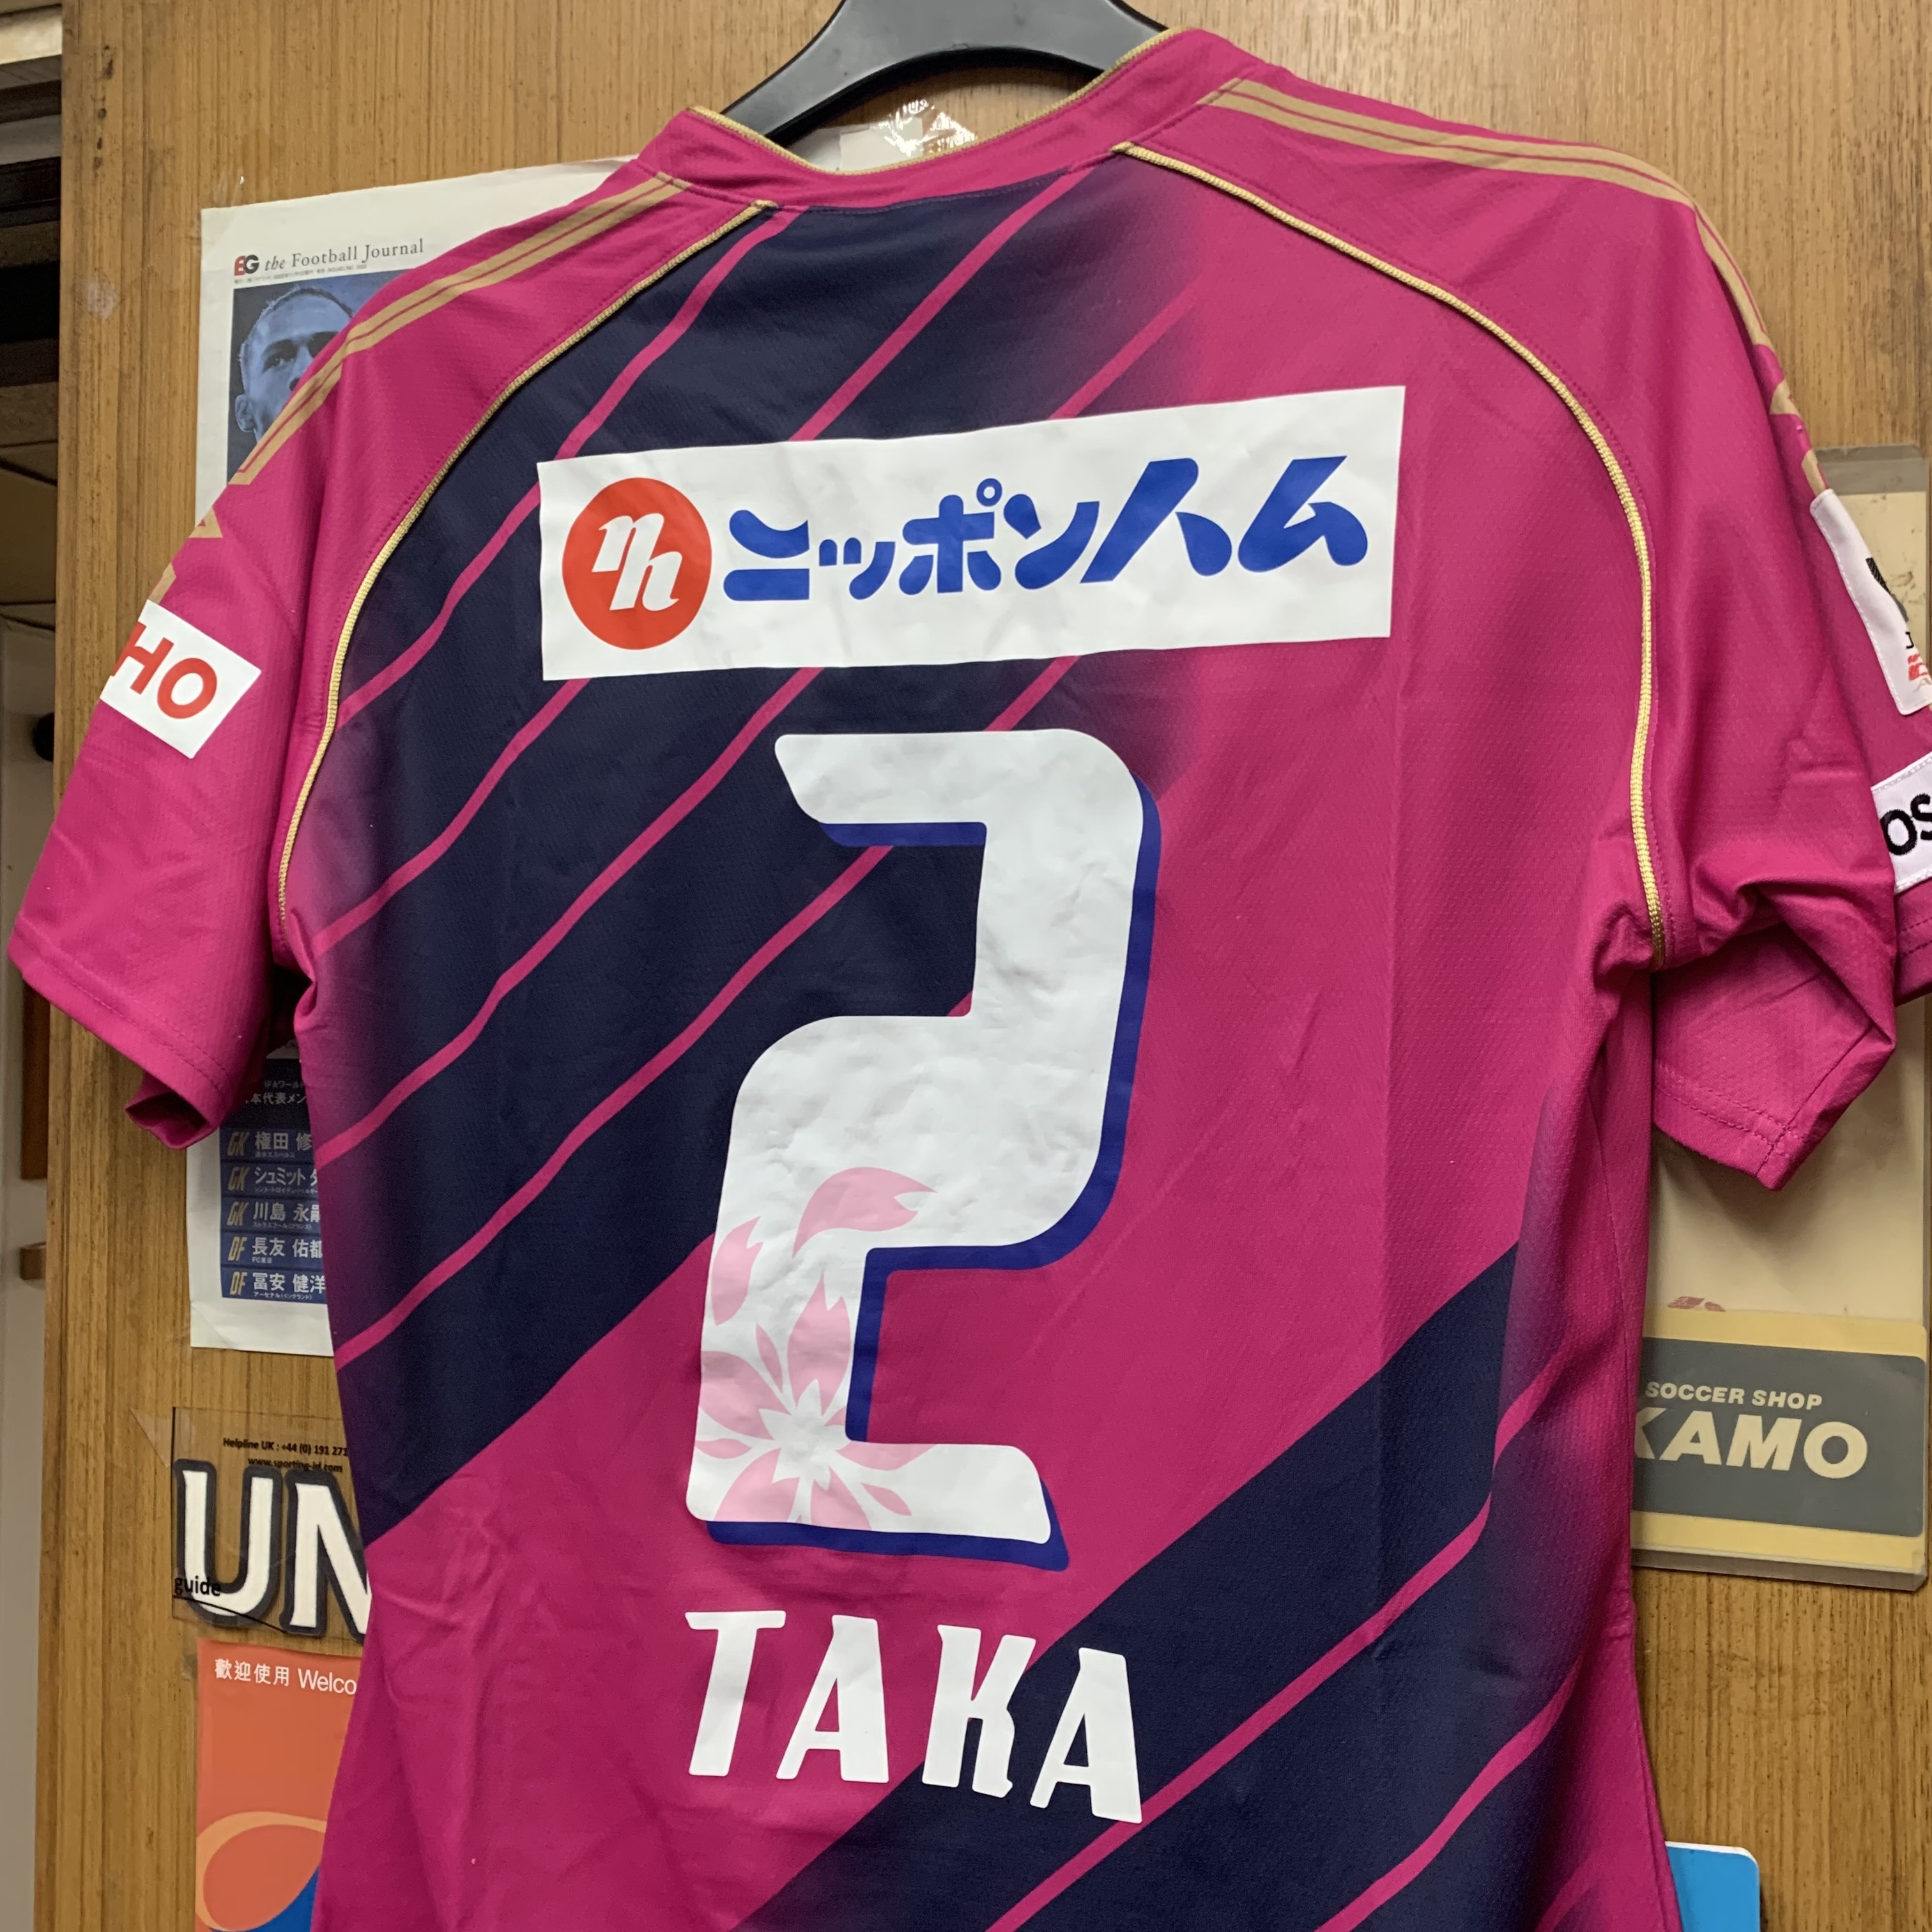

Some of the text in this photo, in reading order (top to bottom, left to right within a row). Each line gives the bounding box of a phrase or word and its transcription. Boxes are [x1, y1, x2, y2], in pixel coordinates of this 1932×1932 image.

[264, 256, 285, 272] the
[291, 245, 357, 268] Football
[362, 238, 424, 263] Journal
[723, 456, 1368, 601] ニッポンハム
[113, 621, 218, 720] HO
[255, 1131, 289, 1151] 権田
[686, 728, 1161, 1570] 2
[254, 1167, 306, 1186] シュミット
[227, 1201, 249, 1226] GK
[253, 1201, 286, 1222] 川島
[228, 1237, 248, 1261] DF
[252, 1237, 286, 1257] 長友
[229, 1271, 248, 1296] DF
[293, 1273, 326, 1294] 健洋
[1645, 1382, 1823, 1410] SOCCER SHOP
[224, 1438, 259, 1450] Helpline
[261, 1441, 274, 1450] UK
[282, 1443, 296, 1452] +44
[299, 1443, 312, 1456] (0)
[314, 1445, 329, 1456] 191
[332, 1446, 348, 1457] 271
[1635, 1407, 1868, 1479] KAMO
[174, 1461, 372, 1642] UN
[174, 1575, 221, 1597] guide
[215, 1659, 356, 1695] 歡迎使用 Welco
[685, 1609, 1142, 1825] TAKA
